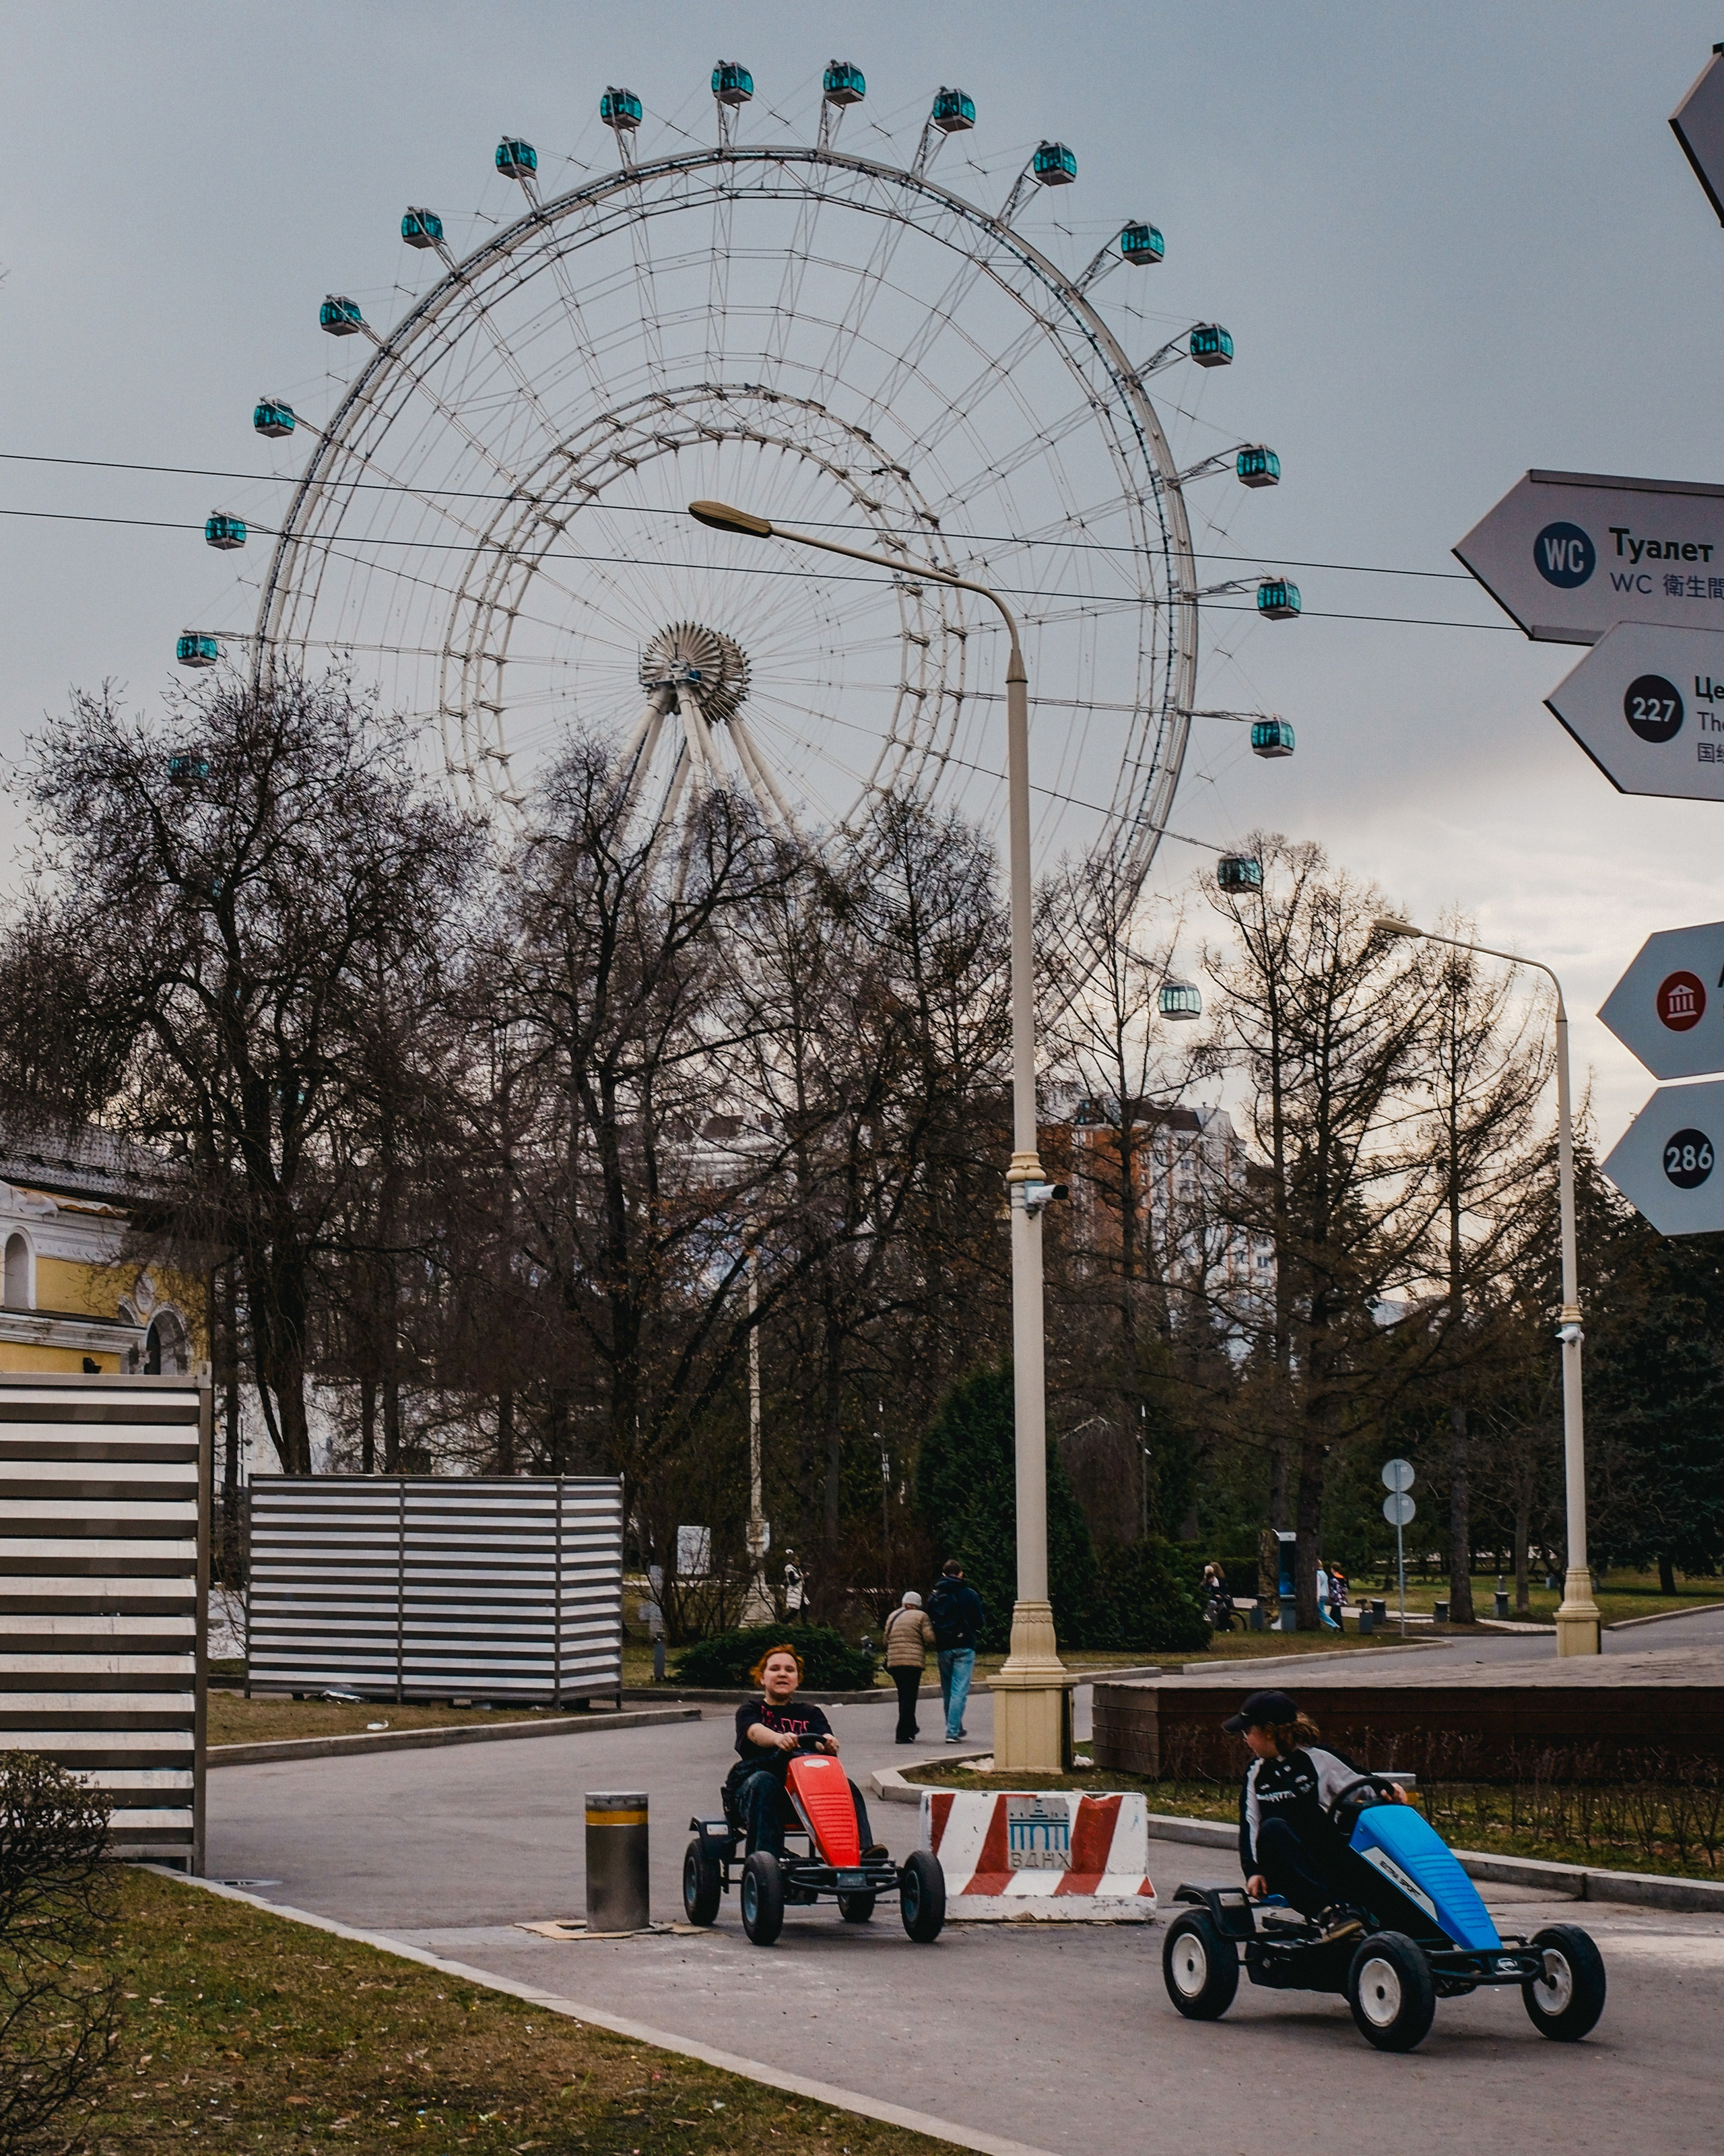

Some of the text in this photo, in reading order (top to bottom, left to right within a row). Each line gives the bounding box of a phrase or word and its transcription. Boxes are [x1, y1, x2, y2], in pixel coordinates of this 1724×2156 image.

[1543, 537, 1584, 573] WC
[1609, 527, 1714, 564] Туалет
[1610, 572, 1653, 594] WC
[1632, 696, 1676, 722] 227
[1665, 1143, 1713, 1174] 286
[1010, 1852, 1072, 1870] ВДНХ
